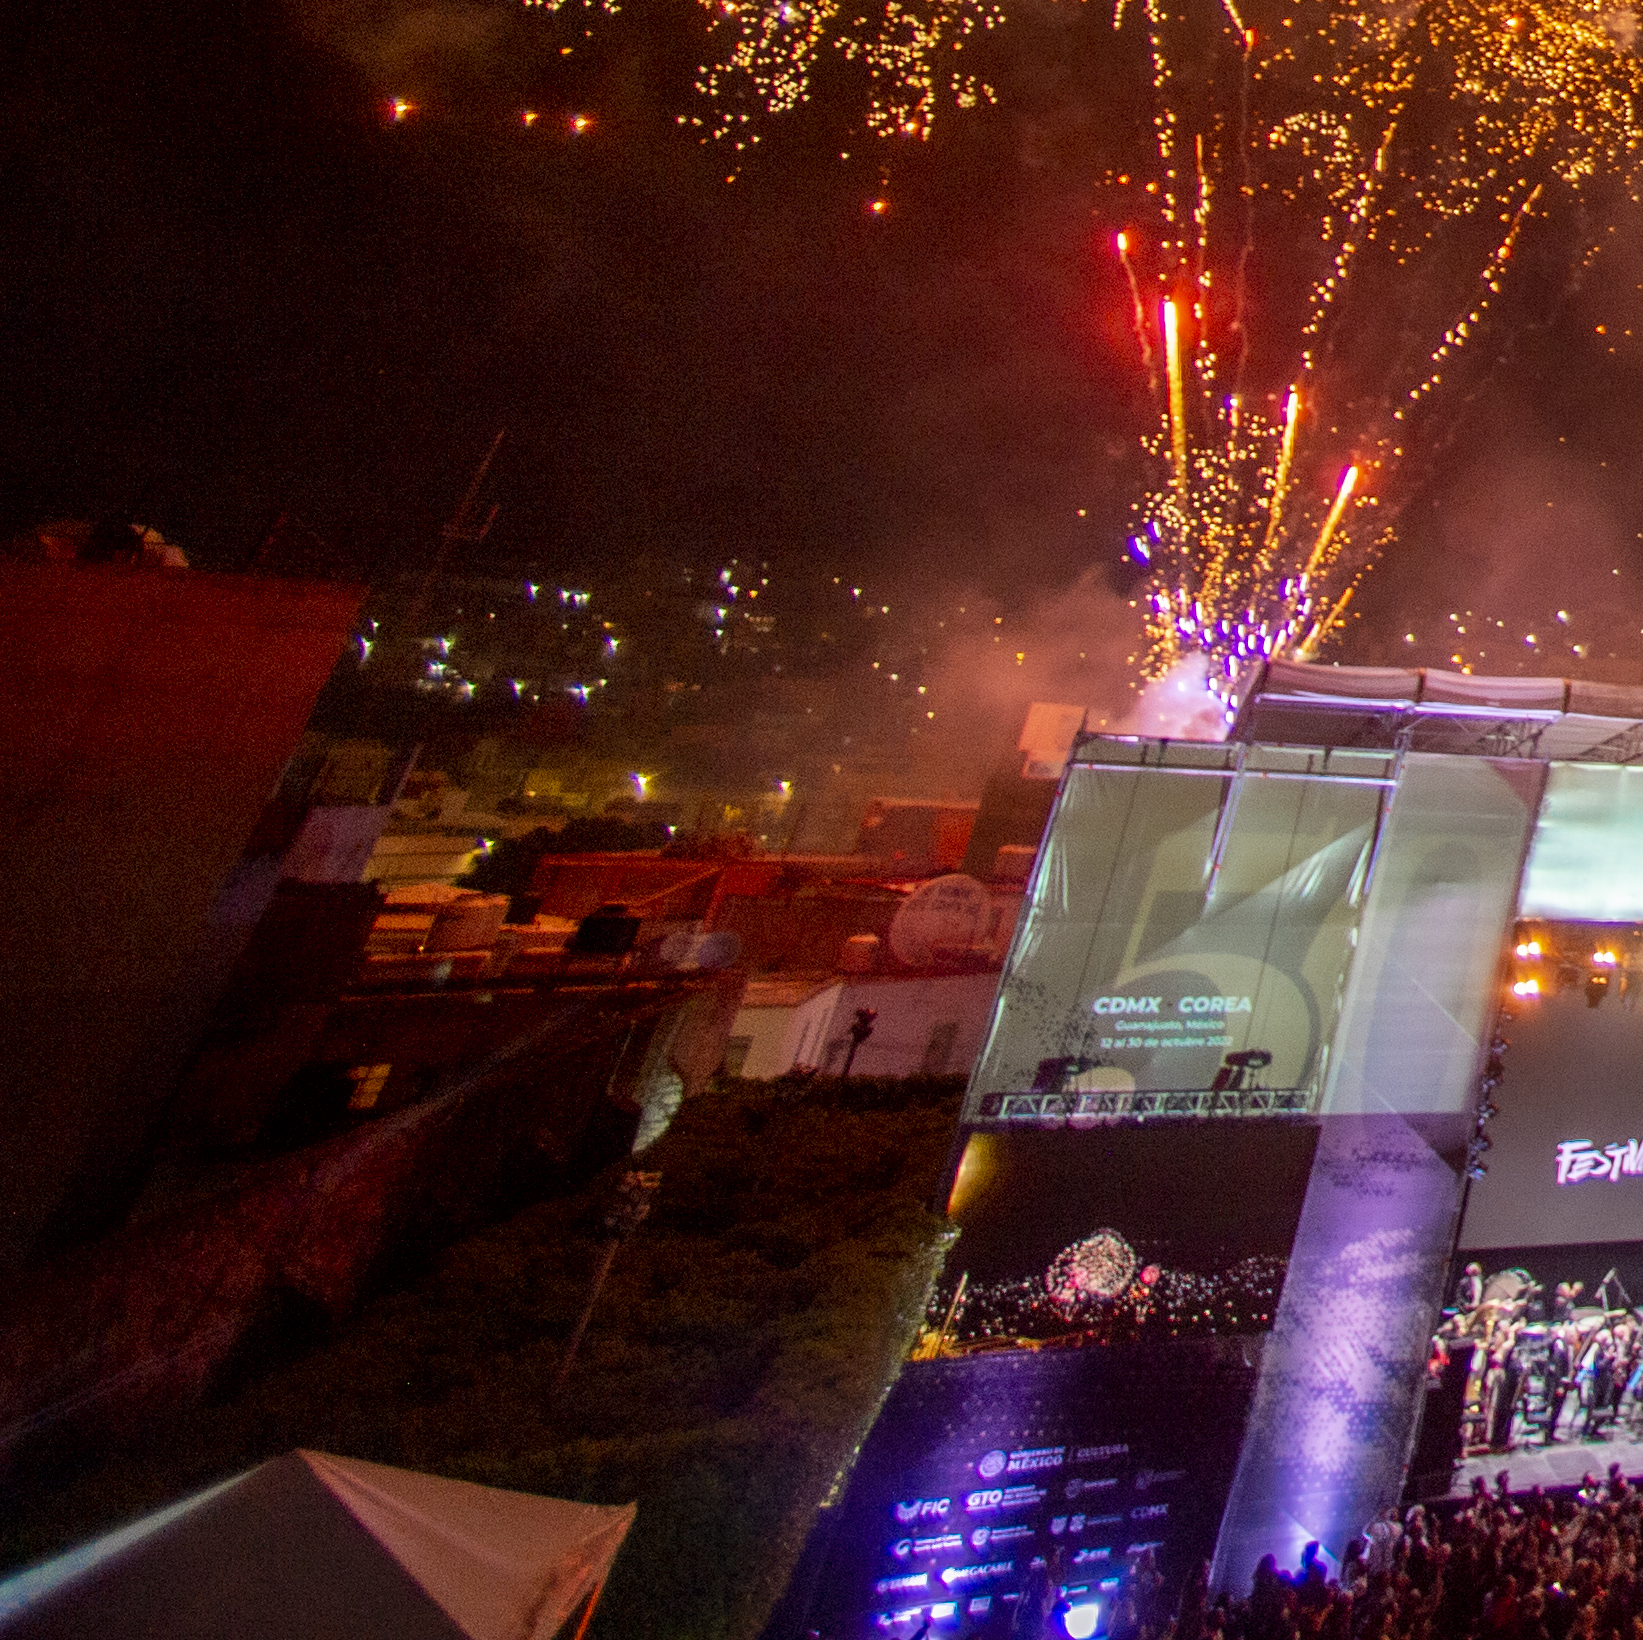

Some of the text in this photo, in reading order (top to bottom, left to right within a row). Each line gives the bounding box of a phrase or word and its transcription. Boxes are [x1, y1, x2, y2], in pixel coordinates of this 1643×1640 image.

[1093, 996, 1252, 1014] CDMX COREA
[1006, 1454, 1063, 1472] MÉXICO
[968, 1489, 1002, 1506] GTO
[920, 1498, 951, 1516] FIC
[1130, 1503, 1168, 1519] CDMX
